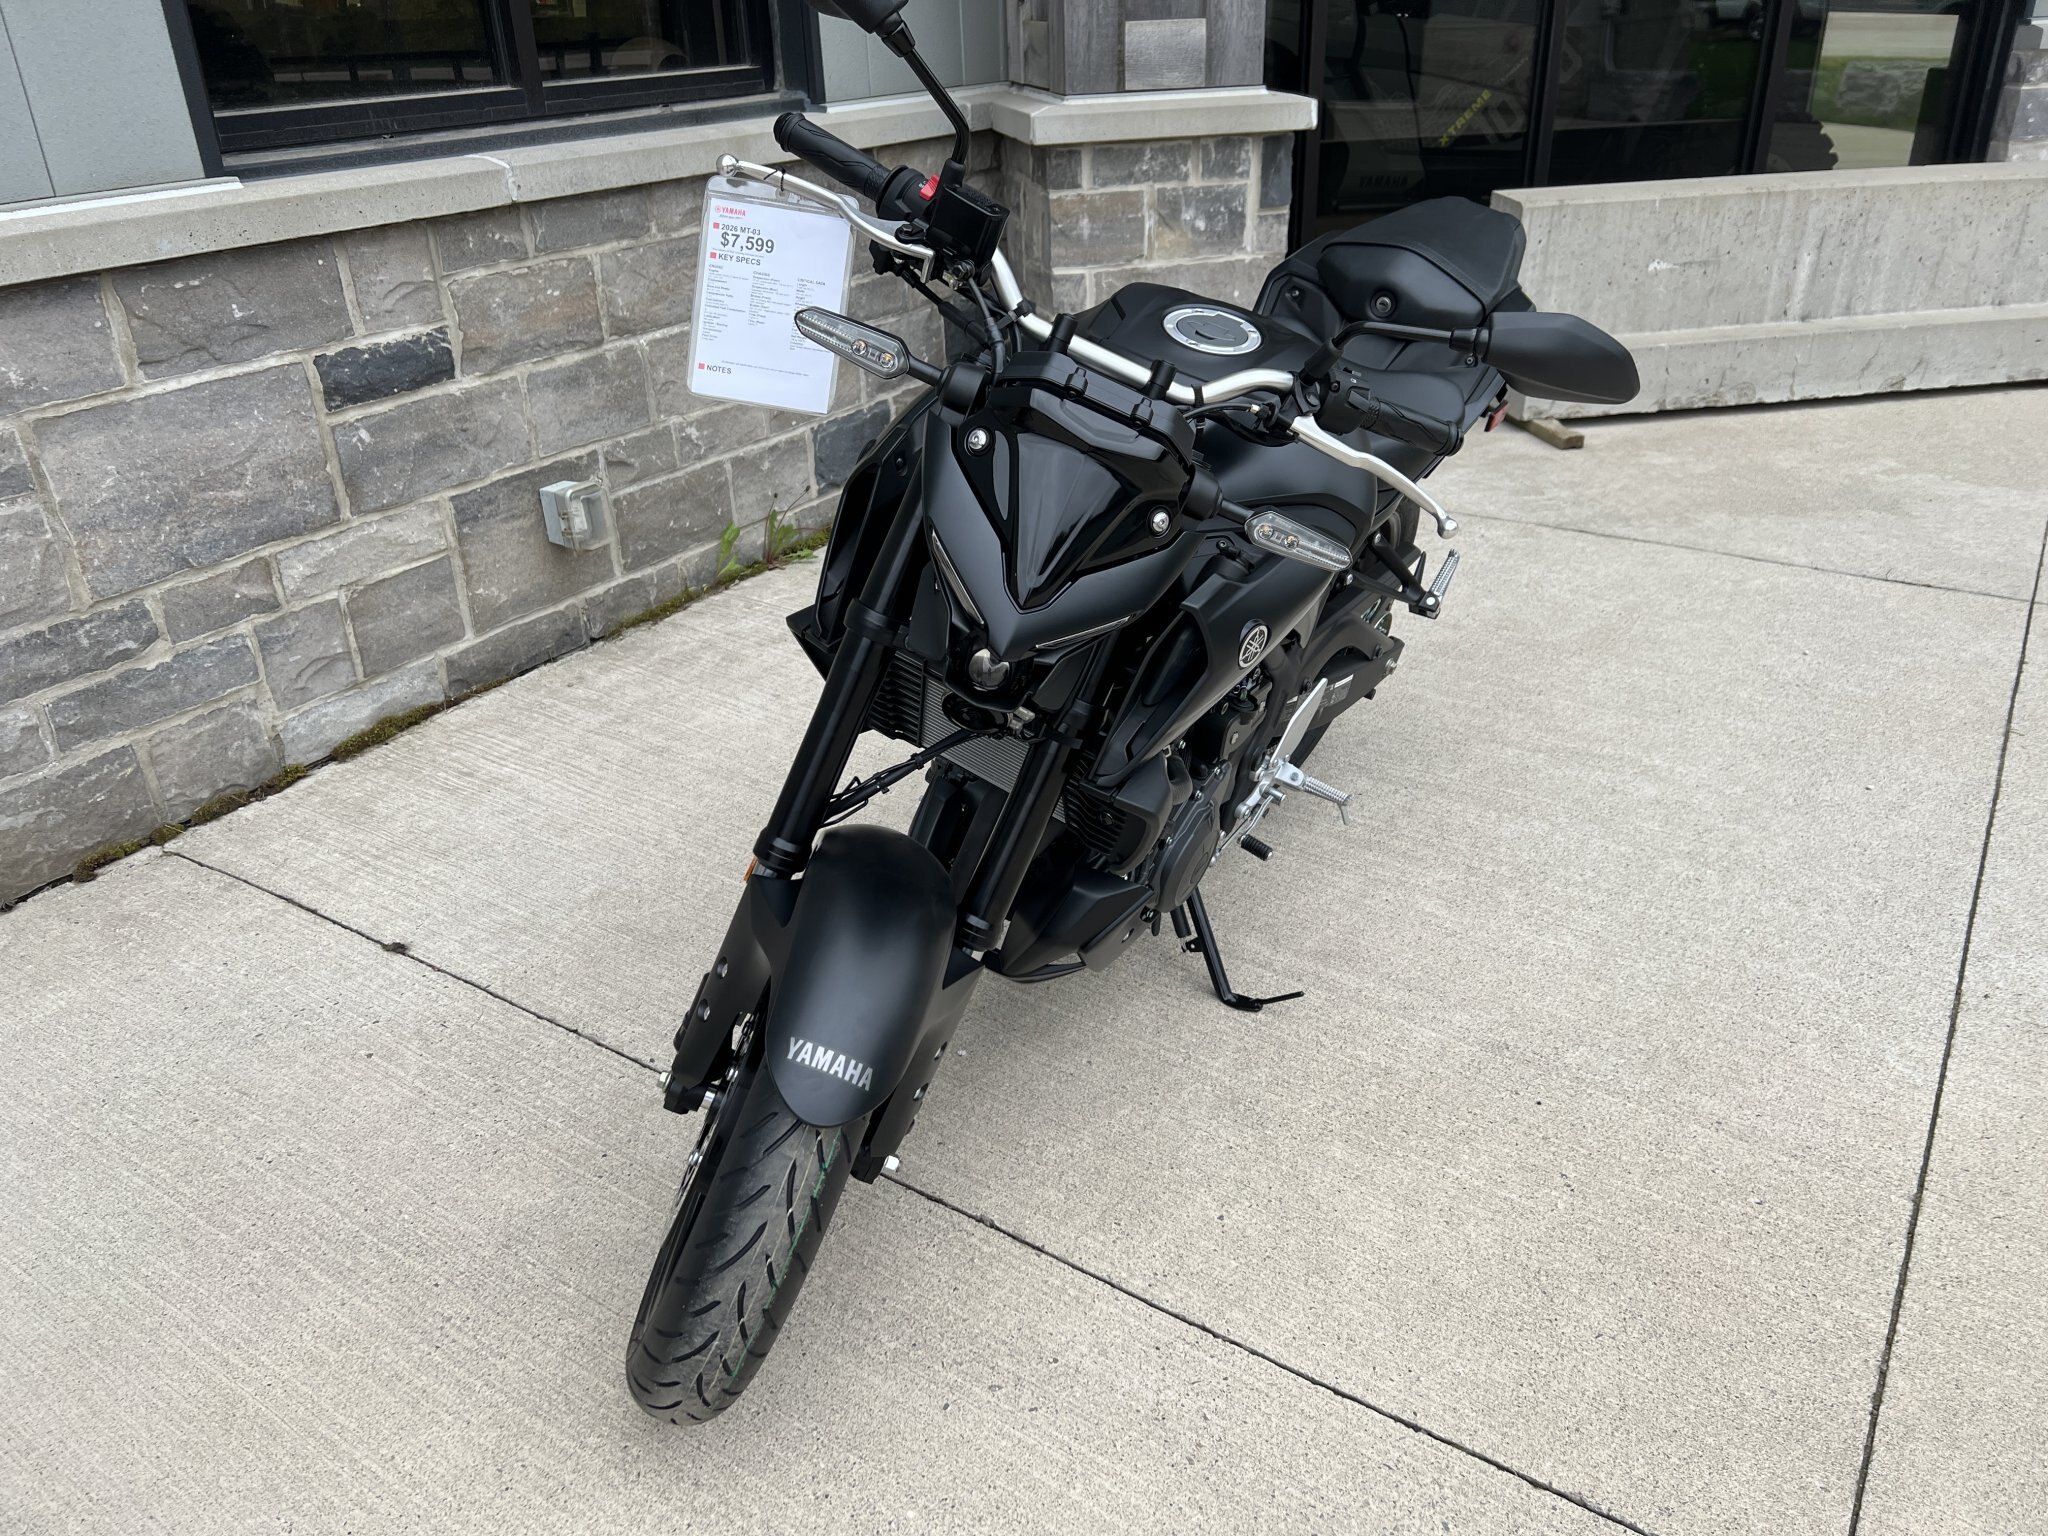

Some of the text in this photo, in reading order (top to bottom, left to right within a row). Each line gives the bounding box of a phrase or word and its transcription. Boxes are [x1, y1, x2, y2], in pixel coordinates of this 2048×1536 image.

[1439, 89, 1492, 147] XTREME
[1360, 175, 1408, 188] YAMAHA
[722, 206, 746, 216] YAMAHA
[721, 223, 761, 236] 2026 MT-03
[720, 231, 775, 254] $7,599
[718, 253, 734, 262] KEY
[735, 256, 761, 266] SPECS
[706, 364, 732, 375] NOTES
[787, 1036, 873, 1092] YAMAHA
